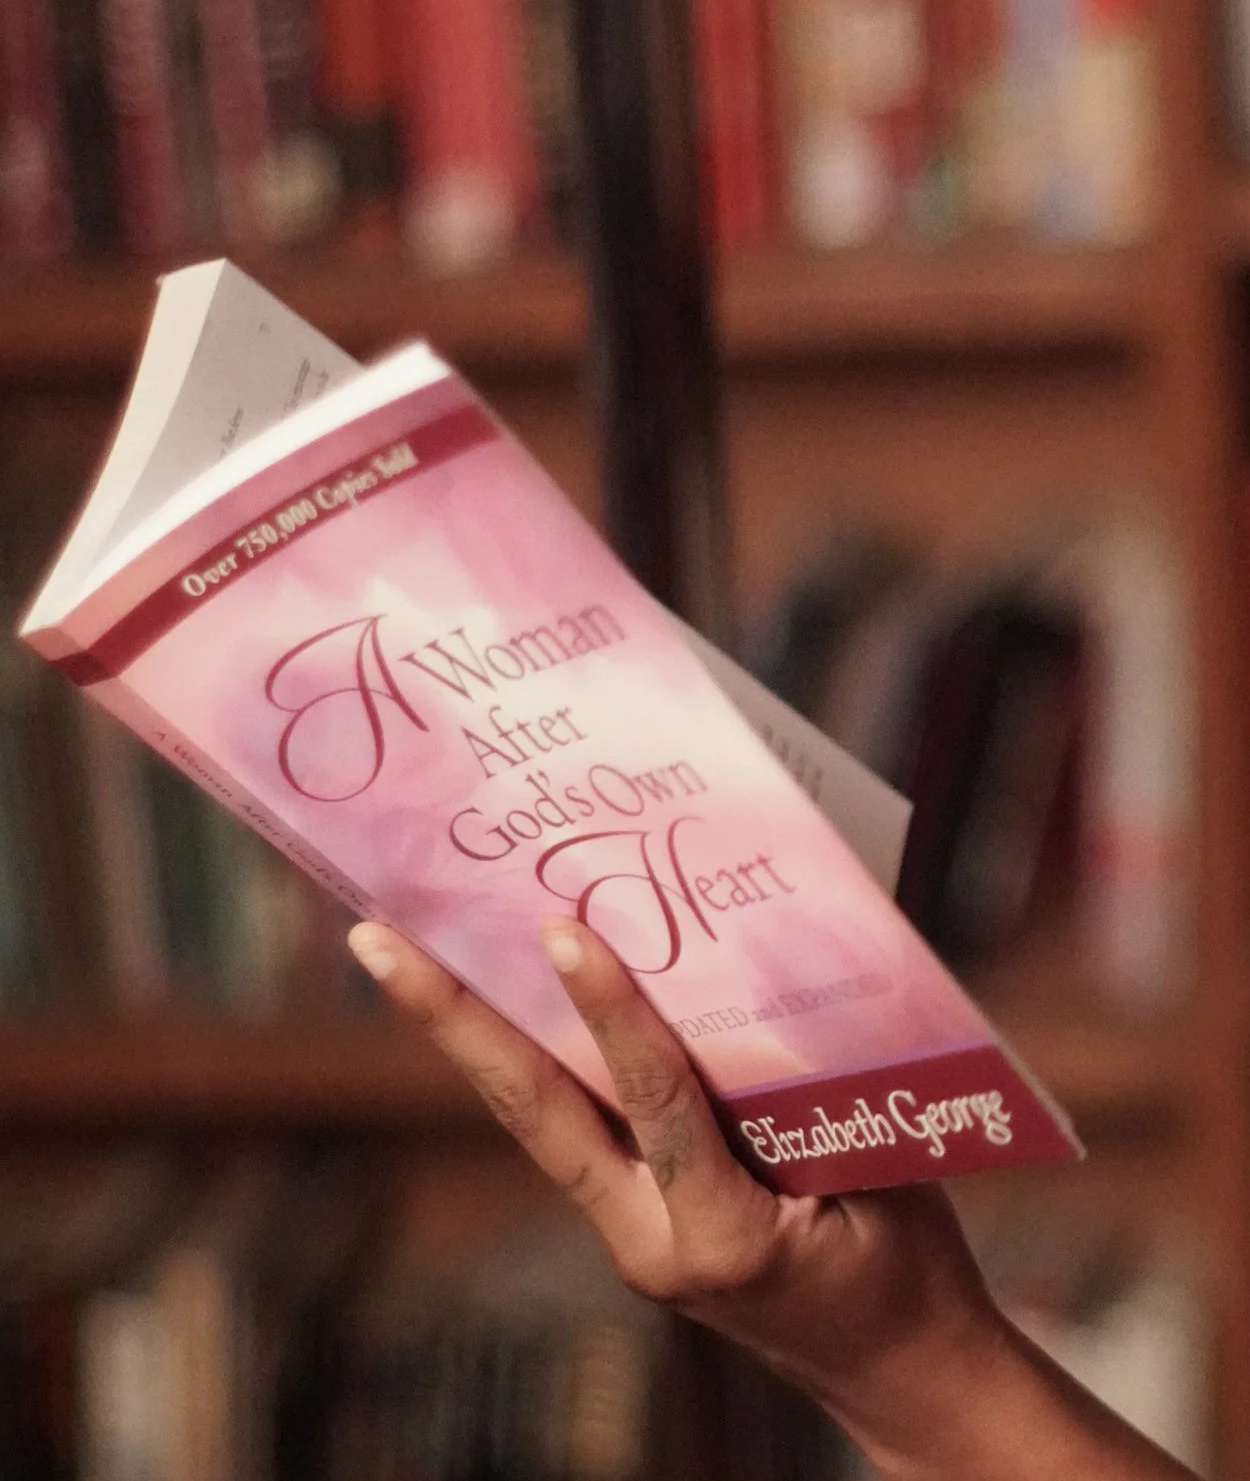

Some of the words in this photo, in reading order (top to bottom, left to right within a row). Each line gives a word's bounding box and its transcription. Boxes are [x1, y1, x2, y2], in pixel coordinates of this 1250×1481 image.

[182, 552, 238, 597] Over
[233, 496, 318, 559] 750,000
[313, 469, 379, 510] Copies
[264, 613, 430, 803] A
[398, 601, 626, 705] Woman
[460, 705, 591, 780] After
[448, 771, 595, 862] God's
[587, 755, 710, 817] Own
[534, 815, 798, 975] Heart
[740, 1098, 897, 1165] Elizabeth
[887, 1089, 1013, 1159] George
